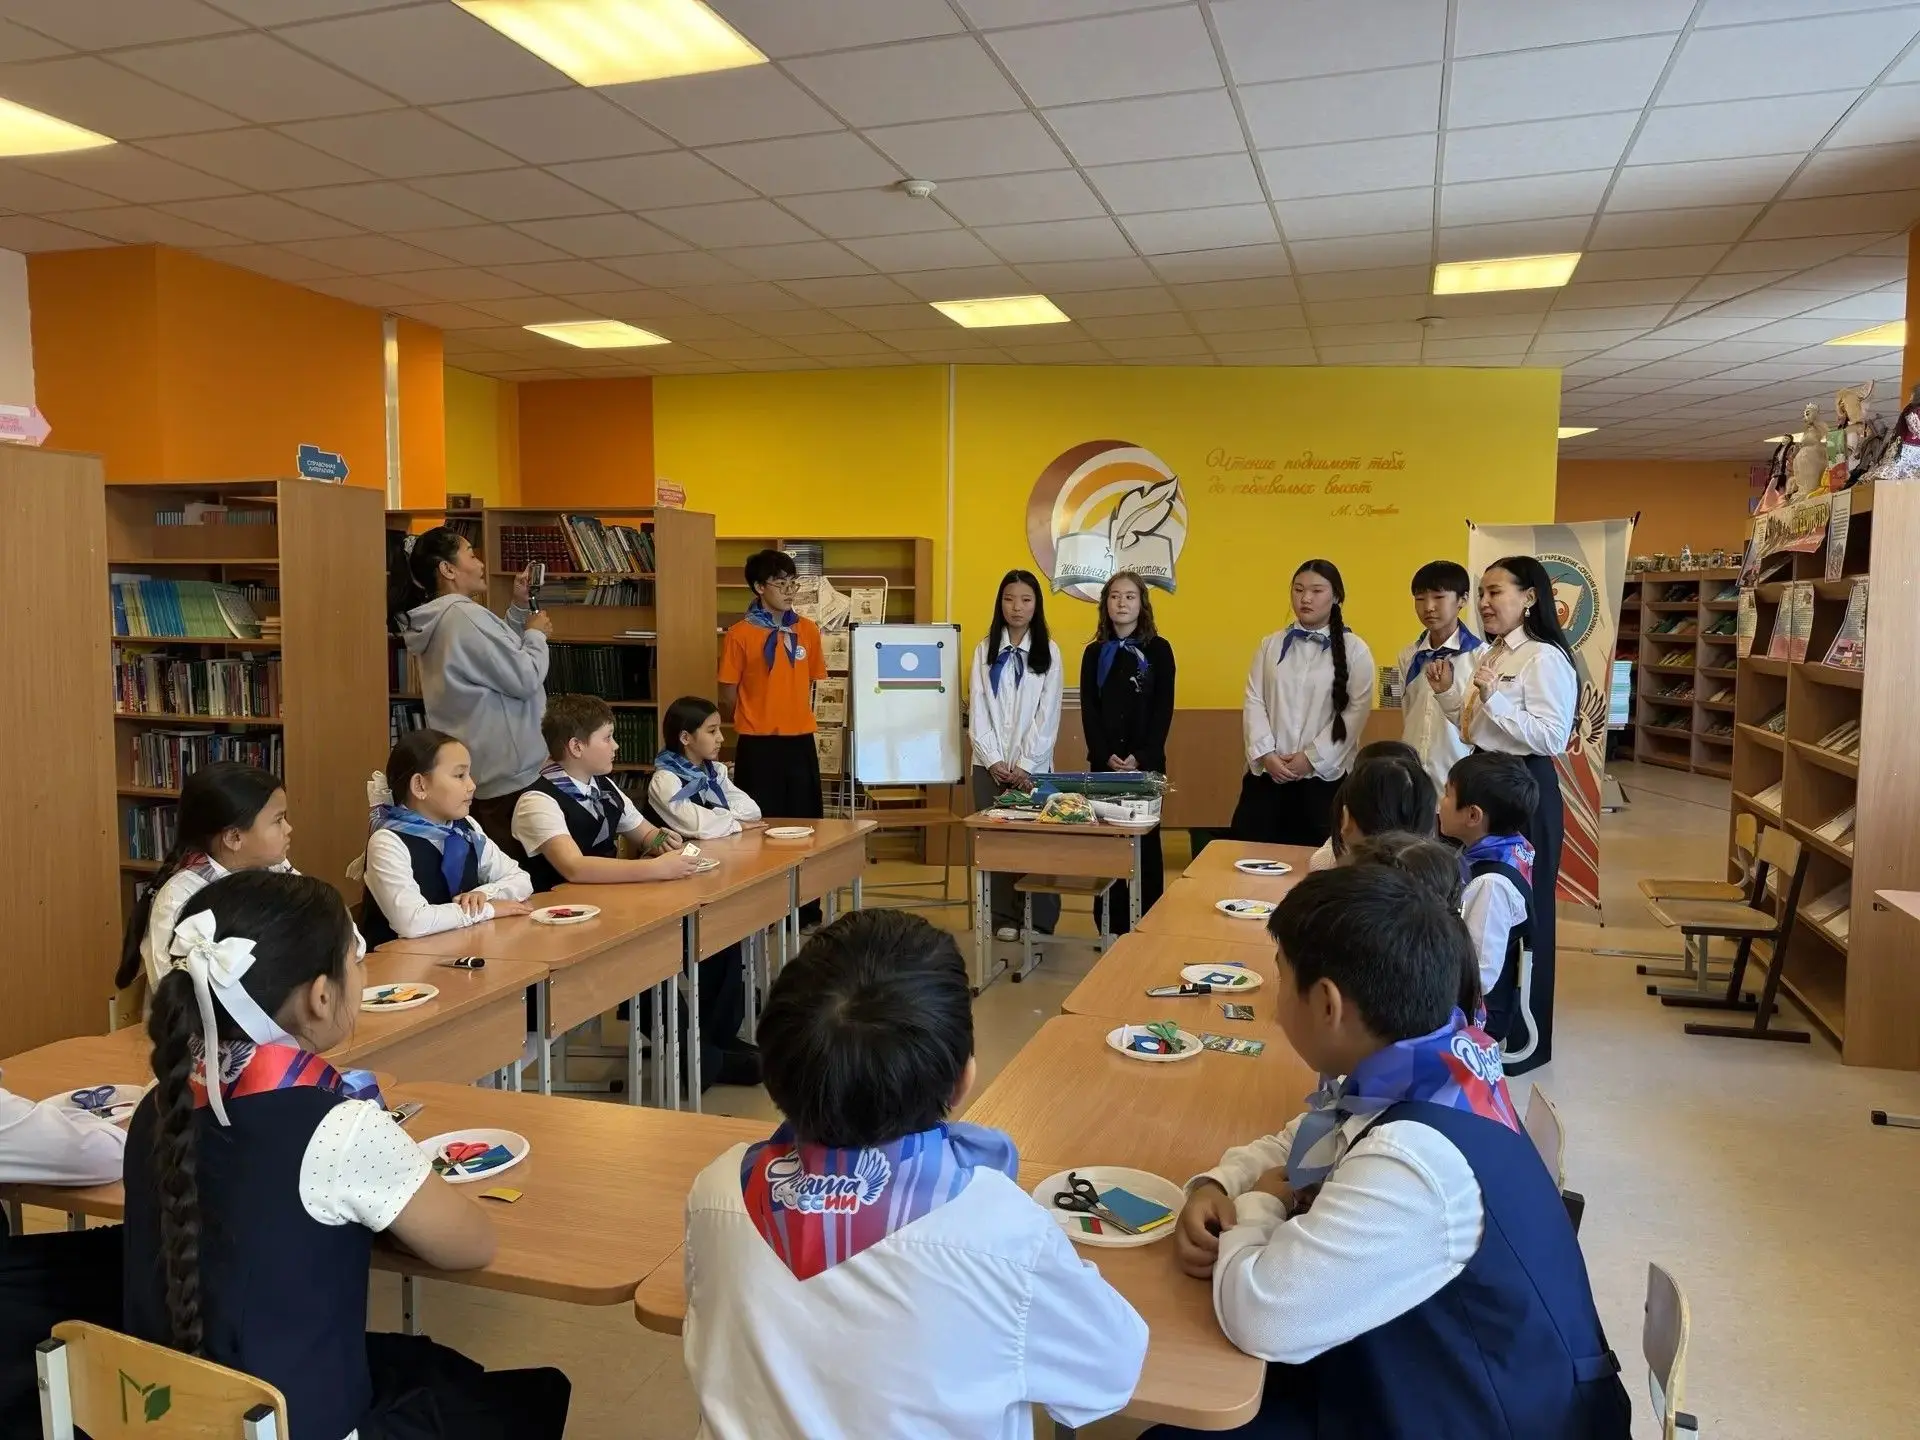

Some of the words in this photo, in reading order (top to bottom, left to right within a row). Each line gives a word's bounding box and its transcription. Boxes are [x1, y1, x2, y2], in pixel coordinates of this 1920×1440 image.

[1284, 450, 1361, 470] поднимет
[1367, 450, 1406, 470] тебя
[1325, 474, 1373, 495] высот
